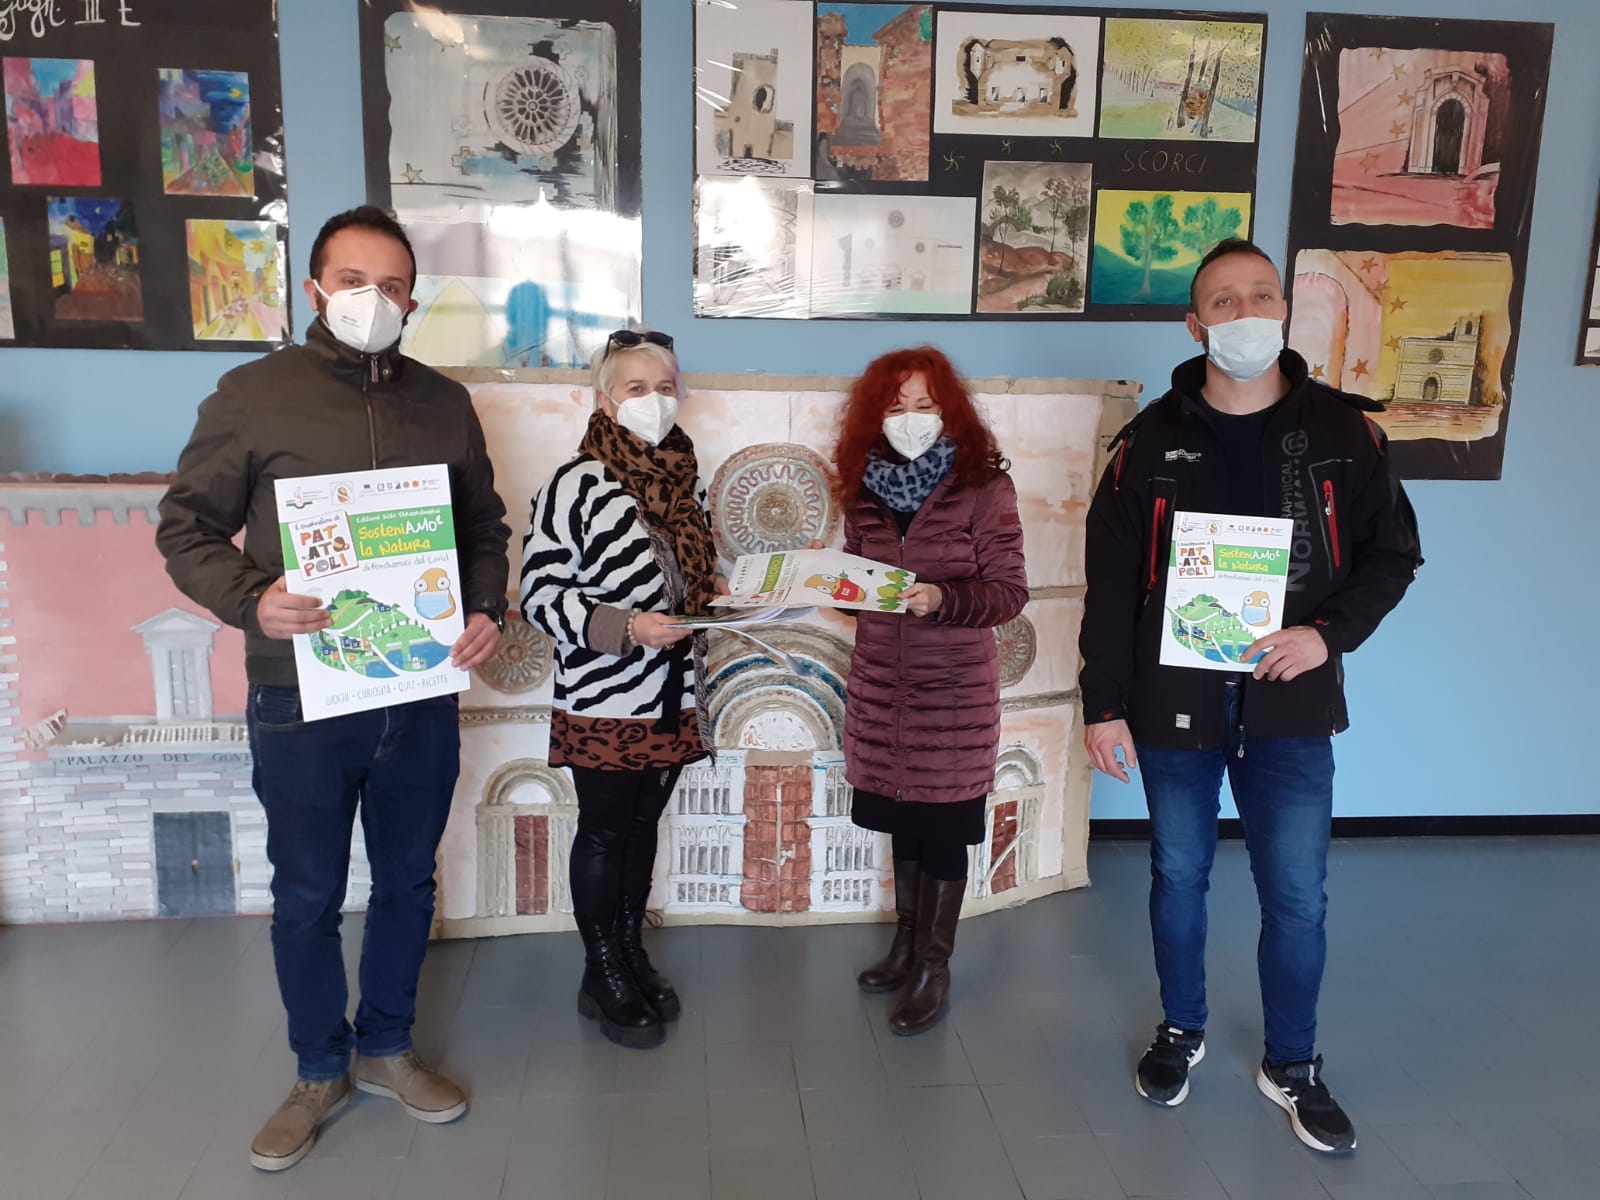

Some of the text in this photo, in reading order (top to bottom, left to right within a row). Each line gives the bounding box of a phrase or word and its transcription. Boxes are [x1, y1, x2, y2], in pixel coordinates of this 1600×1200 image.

[1120, 149, 1208, 174] SCORCI
[1286, 458, 1312, 591] NORW
[300, 524, 338, 546] PAT
[308, 536, 349, 560] ATO
[360, 541, 374, 558] la
[1180, 547, 1206, 557] PAT
[304, 552, 349, 577] POLI
[1182, 555, 1211, 567] ATO
[1178, 566, 1209, 577] POLI
[67, 752, 252, 766] PALAZZO DEL GOVE
